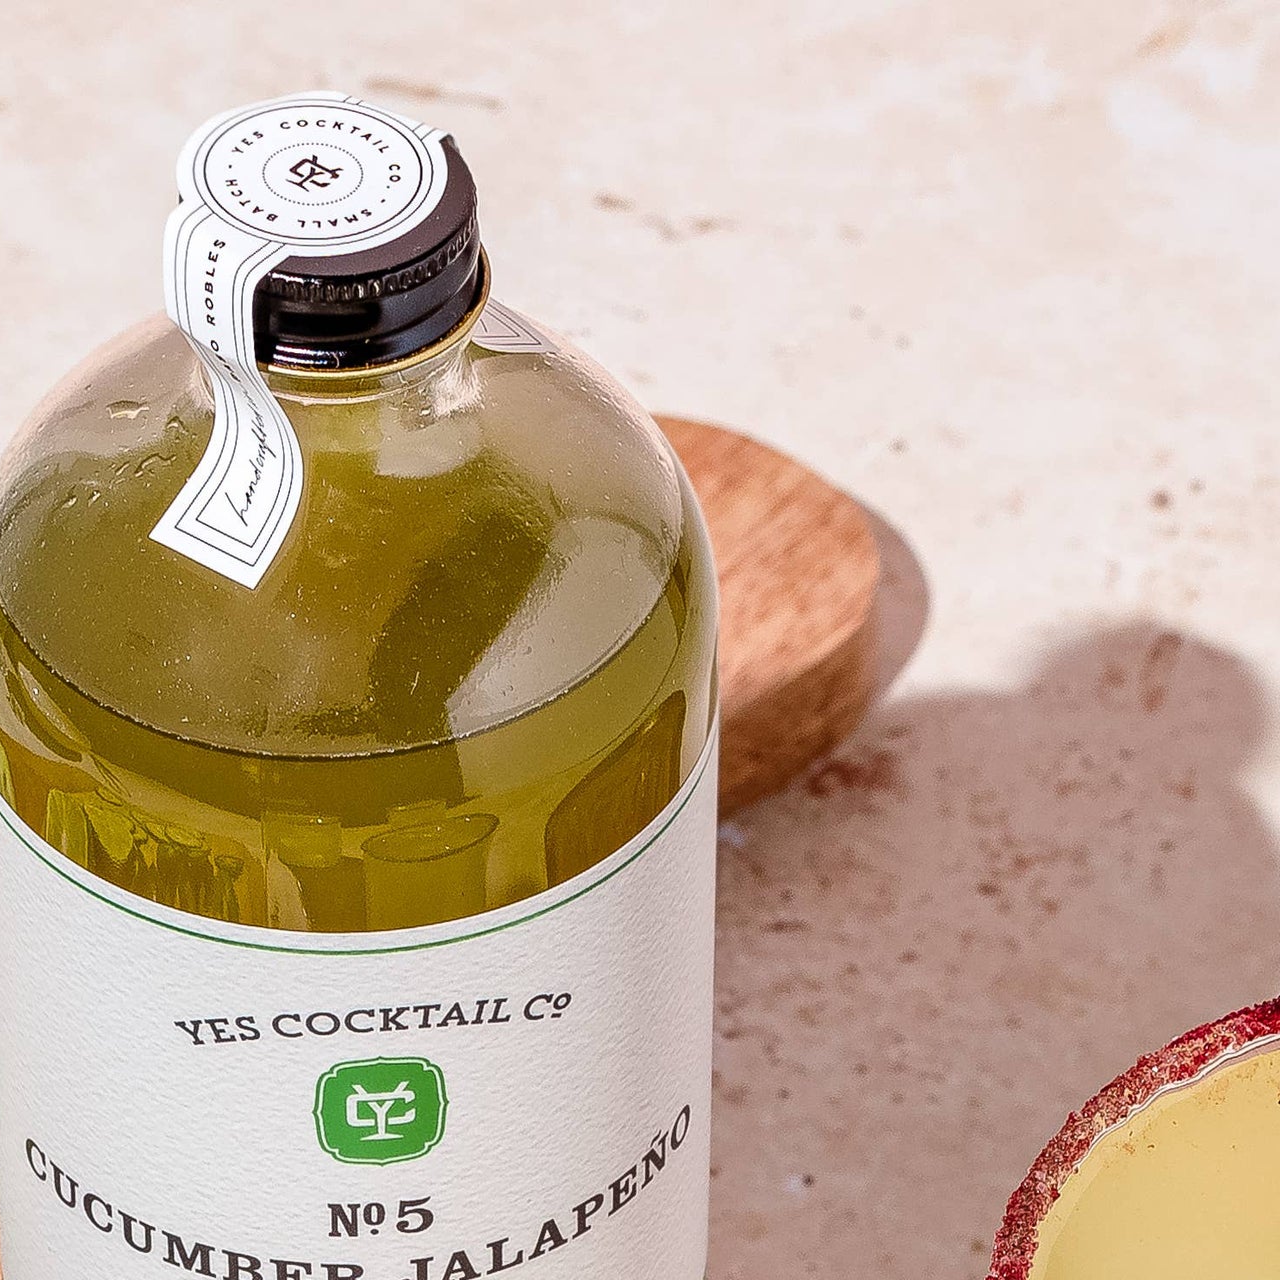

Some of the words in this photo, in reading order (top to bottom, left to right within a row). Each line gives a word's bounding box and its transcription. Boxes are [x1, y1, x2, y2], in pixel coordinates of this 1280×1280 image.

[231, 131, 264, 155] YES
[279, 119, 390, 154] COCKTAIL
[225, 179, 278, 222] BATCH
[297, 208, 373, 228] SMALL
[204, 239, 226, 326] ROBLES
[174, 1015, 261, 1045] YES
[272, 998, 512, 1038] COCKTAIL
